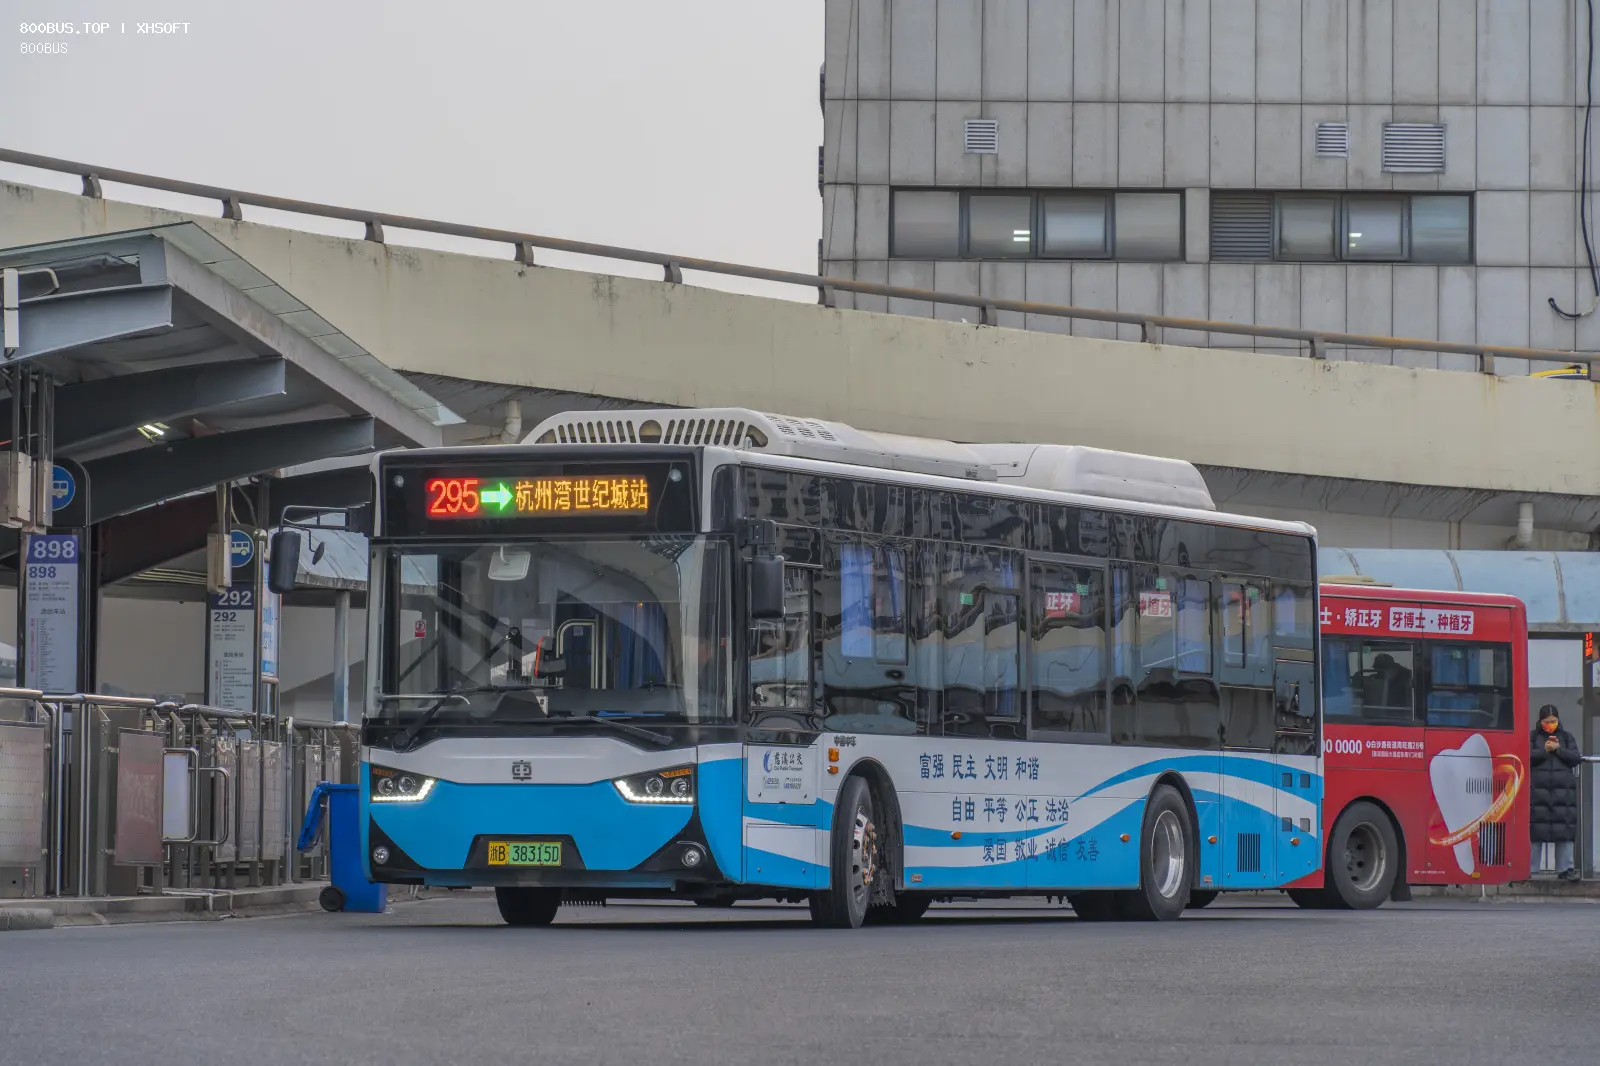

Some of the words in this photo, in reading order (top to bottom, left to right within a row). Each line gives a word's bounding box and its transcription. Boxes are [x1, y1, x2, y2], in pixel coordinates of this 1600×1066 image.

[430, 479, 479, 513] 295
[515, 480, 648, 512] 杭州湾世纪城站
[33, 540, 75, 559] 898
[28, 566, 57, 579] 898
[218, 590, 252, 606] 292
[214, 611, 237, 622] 292
[1392, 611, 1472, 631] 牙博士·种植牙
[919, 753, 945, 779] 富强
[952, 754, 978, 780] 民主
[984, 754, 1008, 781] 文明
[1014, 756, 1040, 781] 和谐
[952, 796, 975, 822] 自由
[983, 797, 1008, 823] 平等
[1014, 799, 1039, 823] 公正
[1045, 798, 1070, 823] 法治
[489, 845, 506, 862] 浙B
[512, 845, 559, 862] 38315D
[983, 838, 1007, 863] 爱国
[1014, 838, 1039, 862] 敬业
[1045, 837, 1070, 863] 诚信
[1075, 837, 1100, 862] 友善
